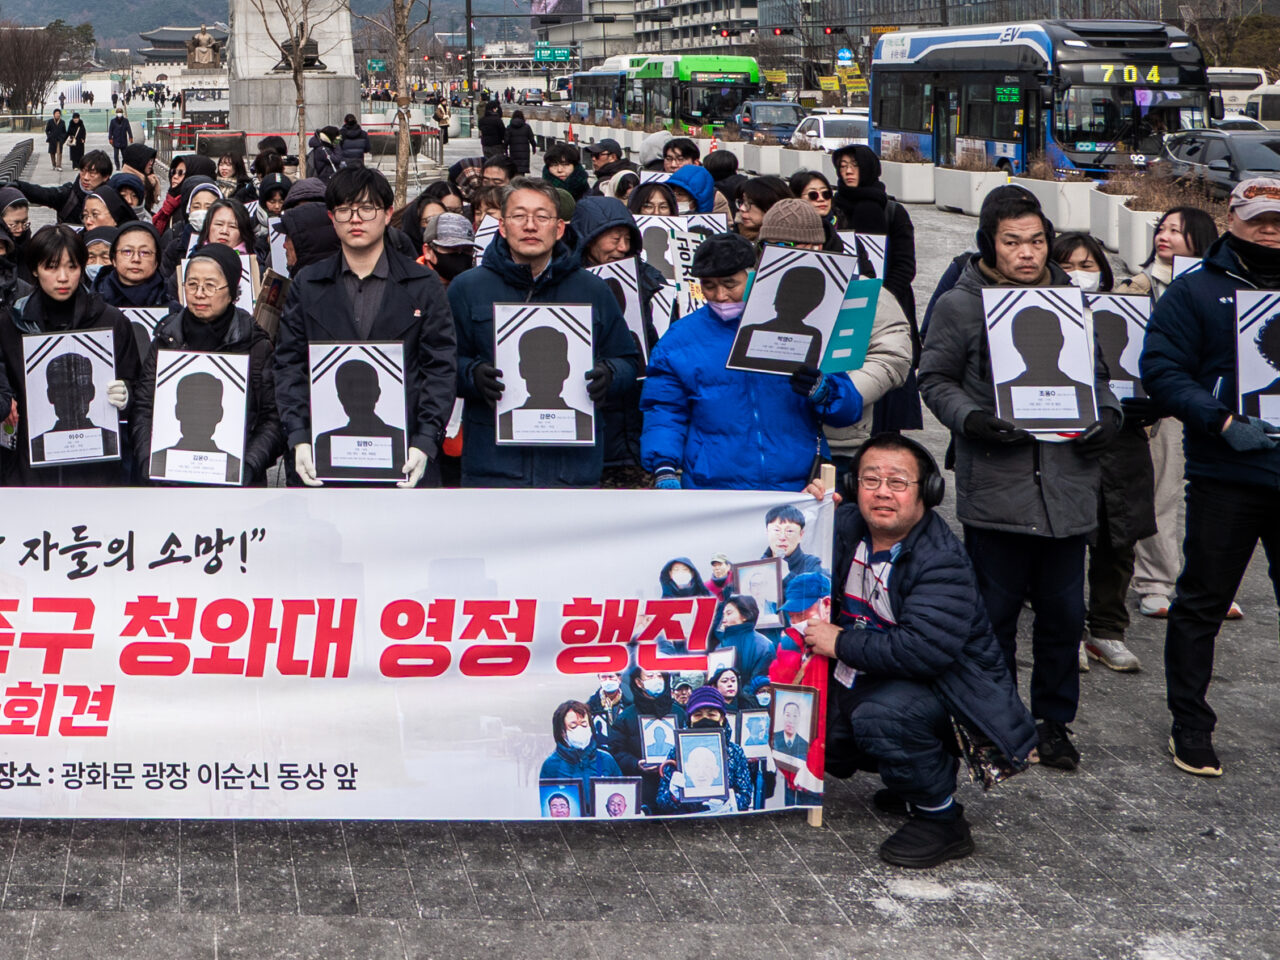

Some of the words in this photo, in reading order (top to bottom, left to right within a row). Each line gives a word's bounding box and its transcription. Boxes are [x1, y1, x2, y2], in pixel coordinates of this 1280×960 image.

[1000, 27, 1022, 43] EV
[1101, 64, 1161, 84] 704
[18, 525, 135, 580] 자들의
[119, 595, 358, 679] 청와대
[379, 599, 537, 678] 영정
[556, 597, 717, 675] 행진
[61, 762, 135, 790] 광화문
[141, 762, 190, 790] 광장
[197, 762, 270, 790] 이순신
[277, 762, 327, 791] 동상
[333, 762, 358, 790] 앞
